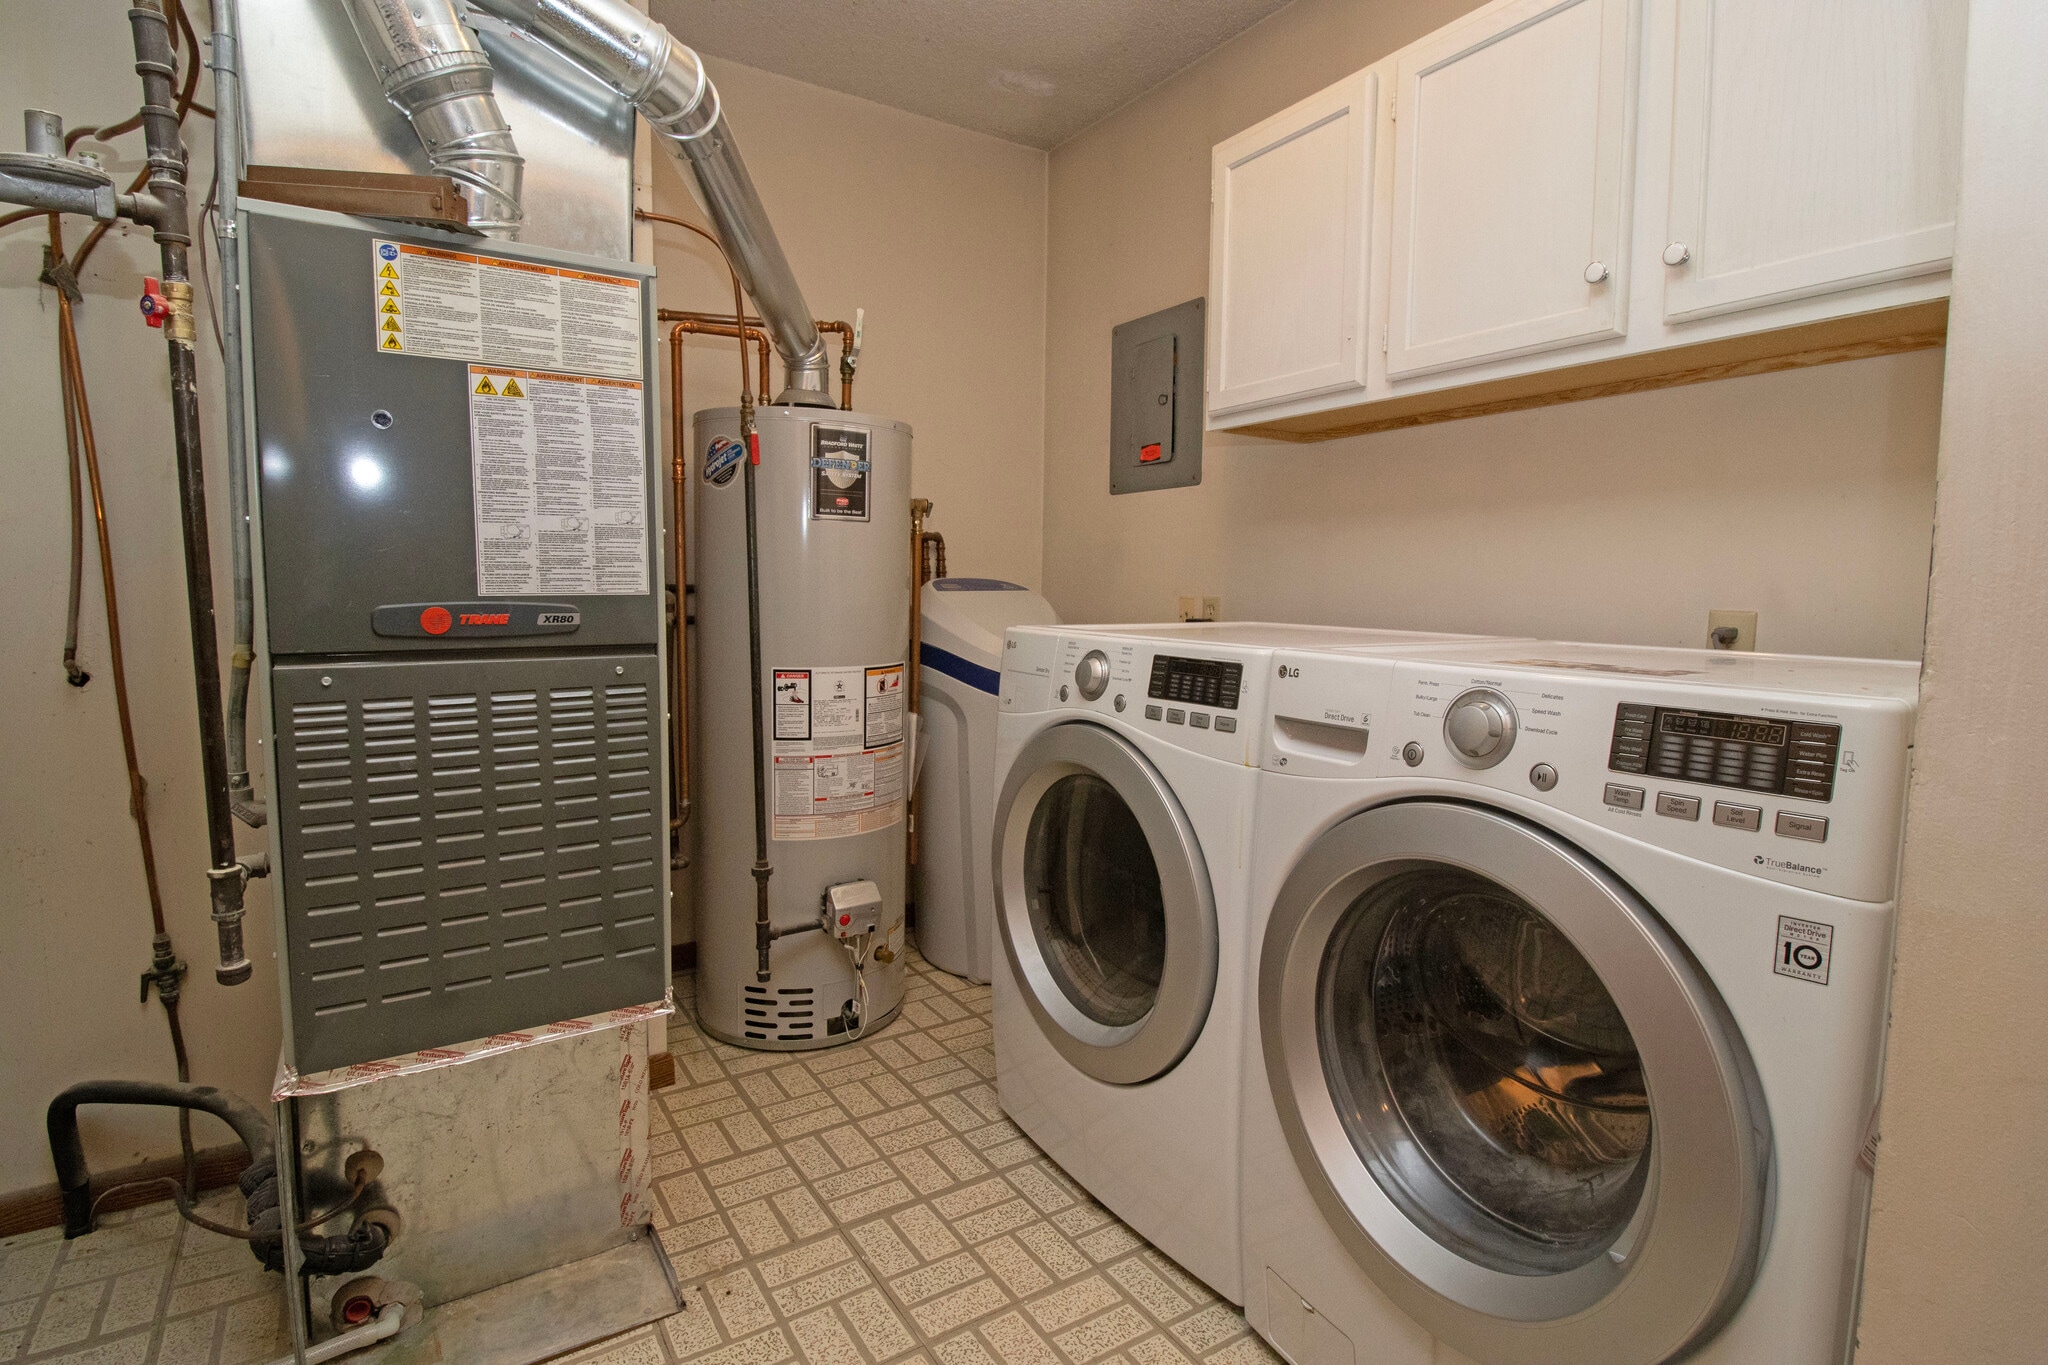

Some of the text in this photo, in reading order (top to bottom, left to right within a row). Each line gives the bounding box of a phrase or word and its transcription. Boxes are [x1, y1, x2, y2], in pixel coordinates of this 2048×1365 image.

[426, 249, 457, 259] WARNING
[498, 260, 547, 274] AVERTISSEMENT
[487, 368, 516, 376] WARNING
[536, 373, 583, 382] AVERTISSEMENT
[597, 380, 636, 388] ADVERTENCIA
[820, 439, 848, 447] BRADFORD
[812, 457, 870, 472] DEFENDER
[459, 613, 574, 625] TRANE XR80
[1011, 641, 1016, 649] LG
[1288, 668, 1299, 678] LG
[1470, 678, 1503, 687] Cotton/Normal
[1541, 692, 1564, 701] Delicates
[1531, 708, 1546, 716] Speed
[1324, 712, 1355, 723] Direct Drive
[1524, 726, 1558, 736] Download Cycle
[1811, 770, 1826, 778] Rinse
[1614, 789, 1631, 798] Wash
[1670, 799, 1685, 807] Spin
[1626, 810, 1642, 819] Rinses
[1666, 805, 1687, 815] Speed
[1730, 808, 1744, 817] Soil
[1726, 815, 1746, 825] Level
[1788, 821, 1812, 832] Signal
[1790, 921, 1821, 930] INVERTER
[1784, 924, 1827, 939] Direct Drive
[1783, 941, 1823, 970] 10
[1799, 953, 1816, 961] YEAR
[1781, 966, 1822, 980] WARRANTY
